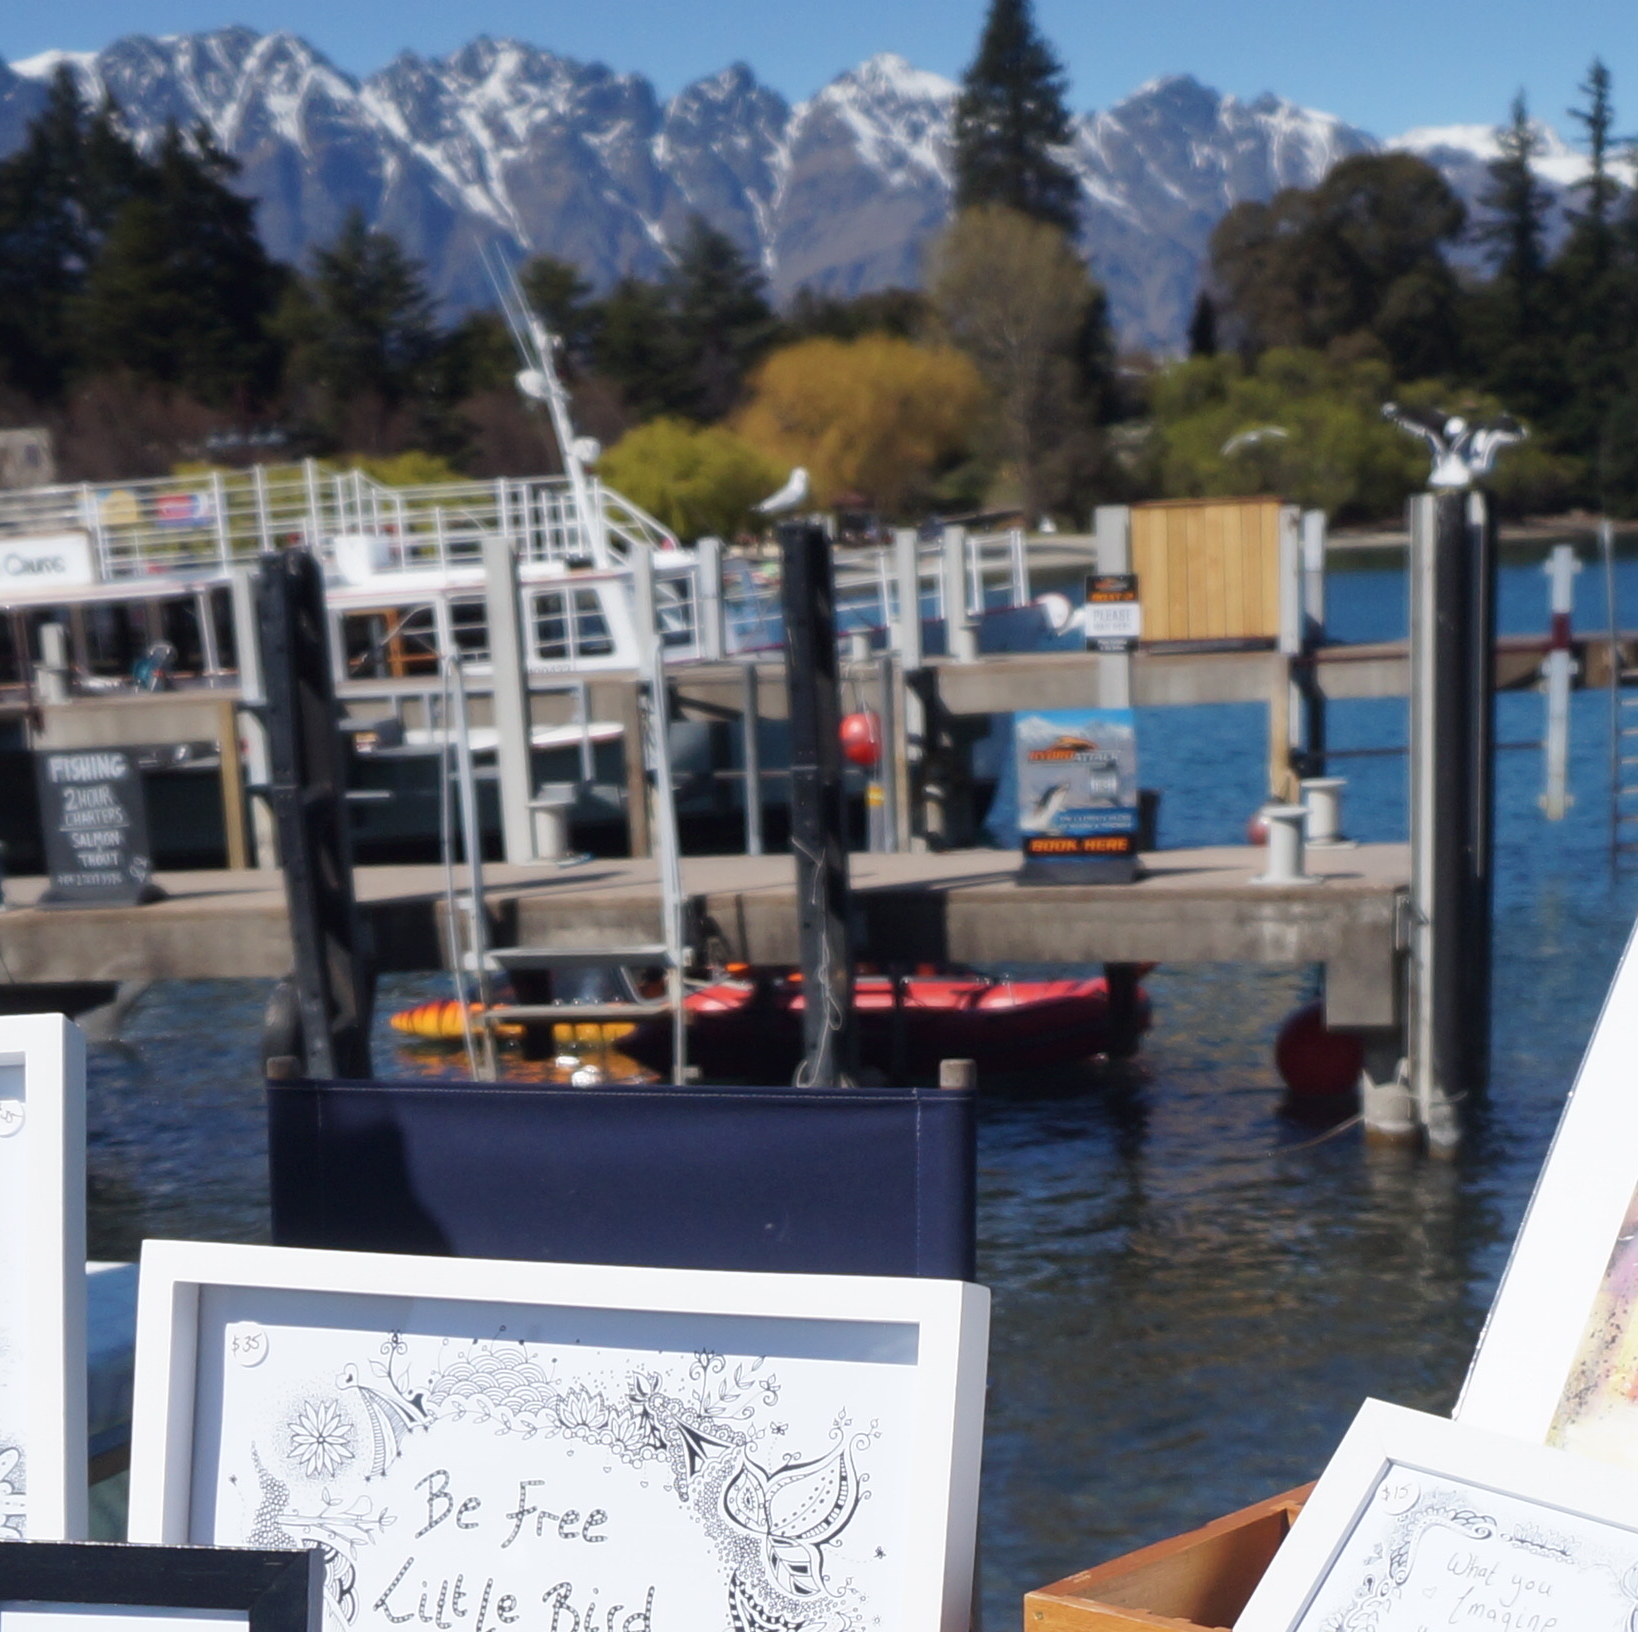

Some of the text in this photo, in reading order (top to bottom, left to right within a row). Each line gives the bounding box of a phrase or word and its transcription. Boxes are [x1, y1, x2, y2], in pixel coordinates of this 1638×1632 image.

[48, 752, 127, 783] FISHING
[63, 784, 113, 811] 2 HOUR
[64, 806, 124, 828] CHARTERS
[71, 830, 121, 849] SALMON
[1084, 837, 1129, 852] HERE
[77, 851, 120, 868] TROUT
[230, 1333, 262, 1356] $35
[1380, 1482, 1410, 1503] $15
[413, 1469, 608, 1548] Be Free
[1446, 1551, 1553, 1608] What you
